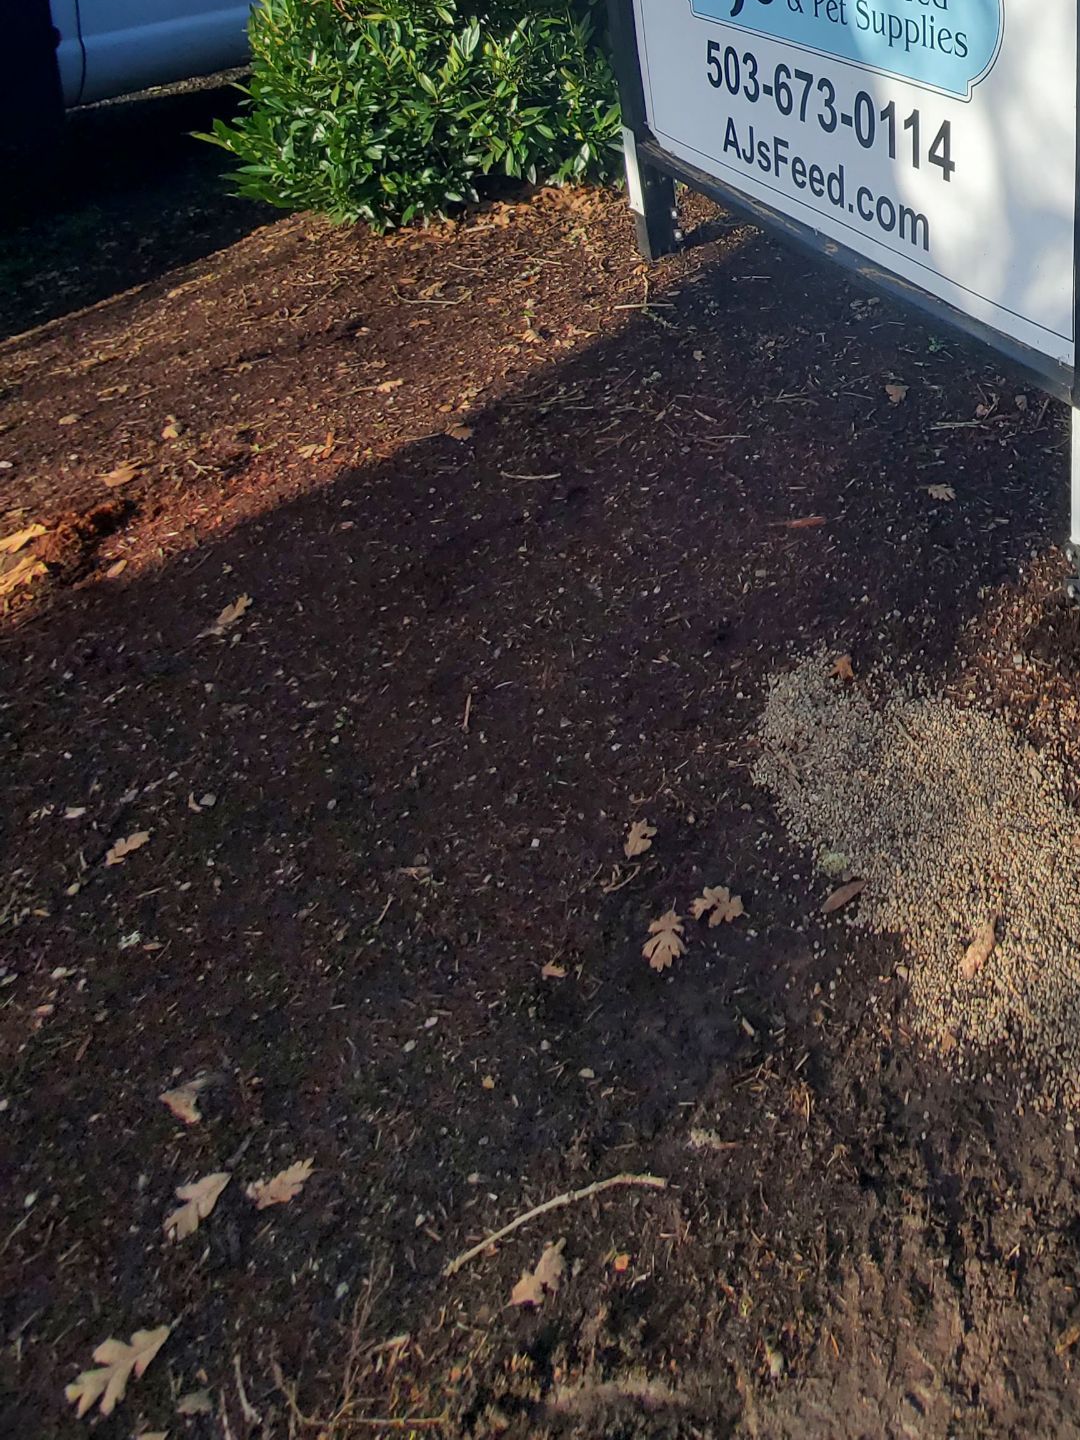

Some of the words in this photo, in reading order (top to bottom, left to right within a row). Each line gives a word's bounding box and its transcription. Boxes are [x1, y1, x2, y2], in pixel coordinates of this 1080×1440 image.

[855, 0, 968, 58] Supplies
[706, 40, 956, 183] 503-673-0114
[723, 117, 930, 251] AJsFeed.com
